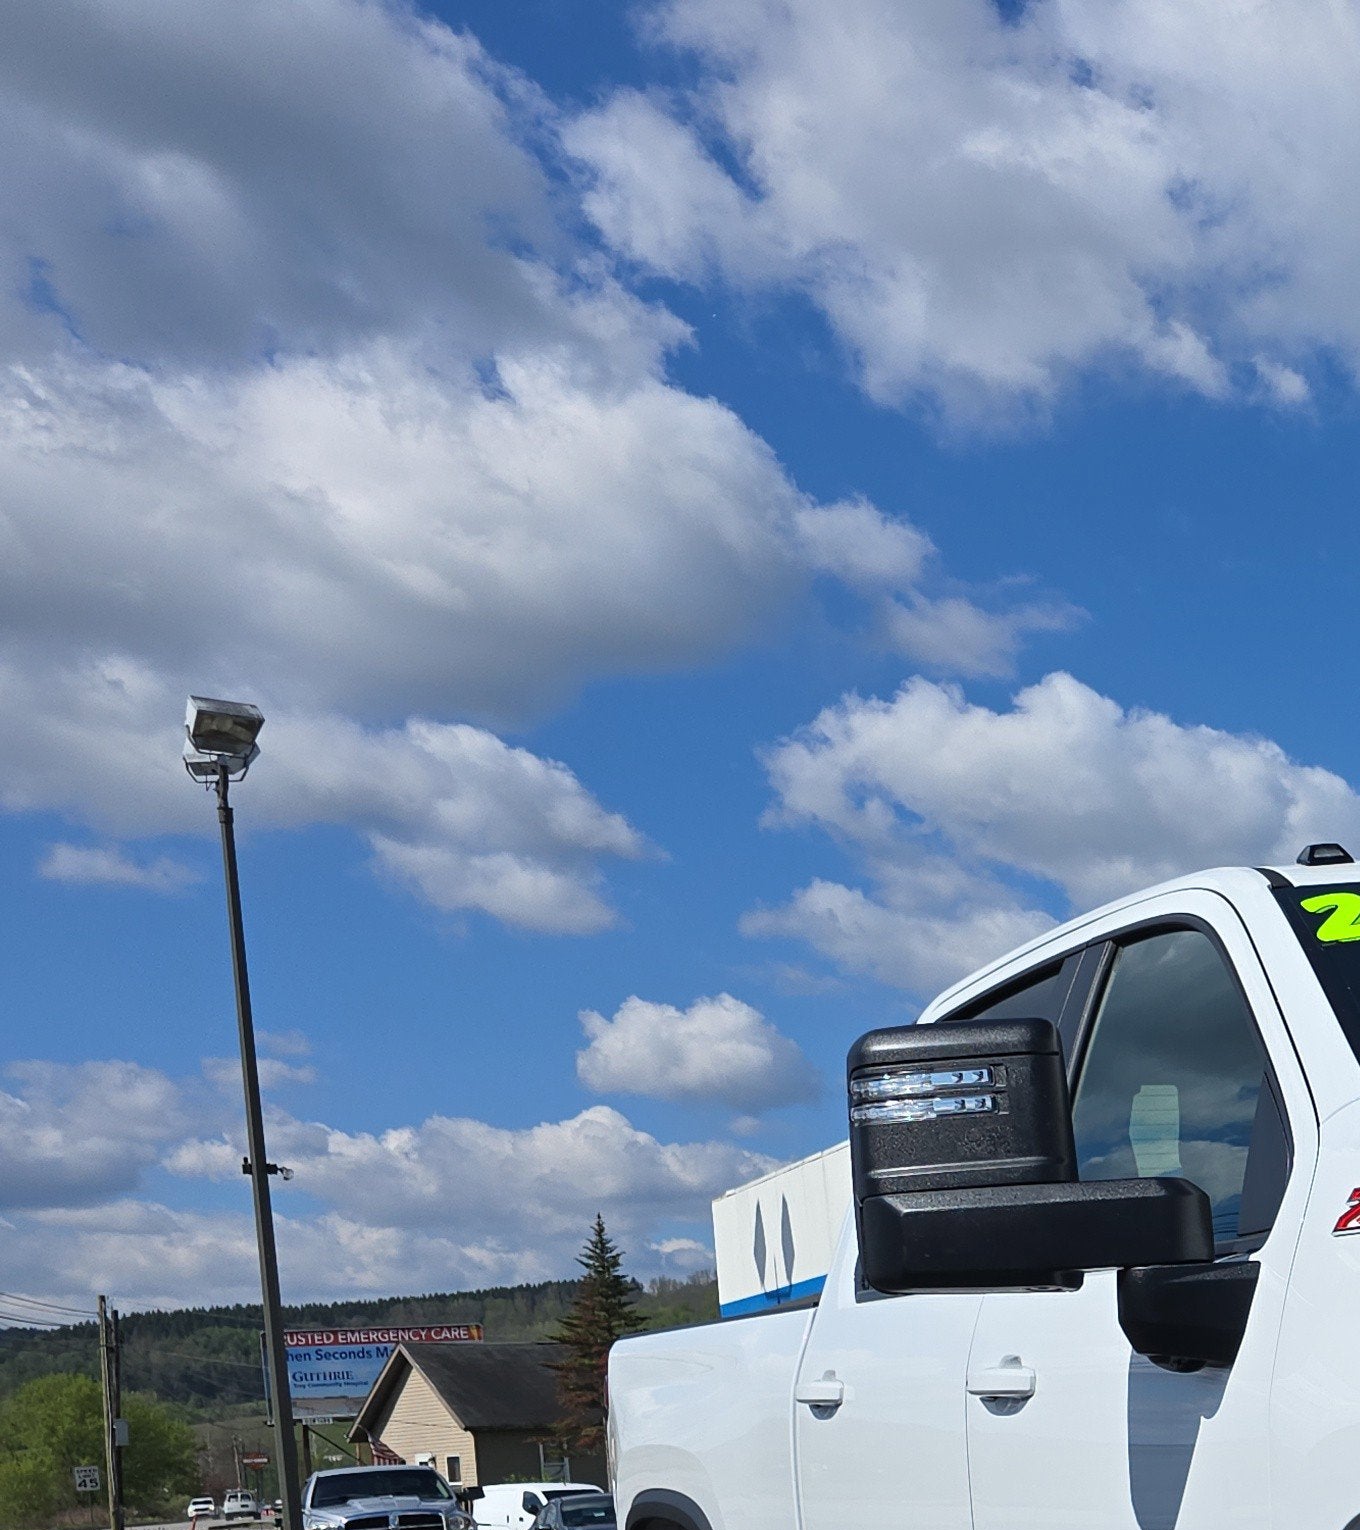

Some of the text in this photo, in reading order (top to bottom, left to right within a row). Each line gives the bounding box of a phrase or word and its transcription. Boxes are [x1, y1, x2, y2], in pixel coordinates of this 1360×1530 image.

[284, 1326, 469, 1346] USTED EMERGENCY CARE
[286, 1353, 312, 1362] hen
[315, 1347, 373, 1361] Seconds
[78, 1479, 98, 1488] 45
